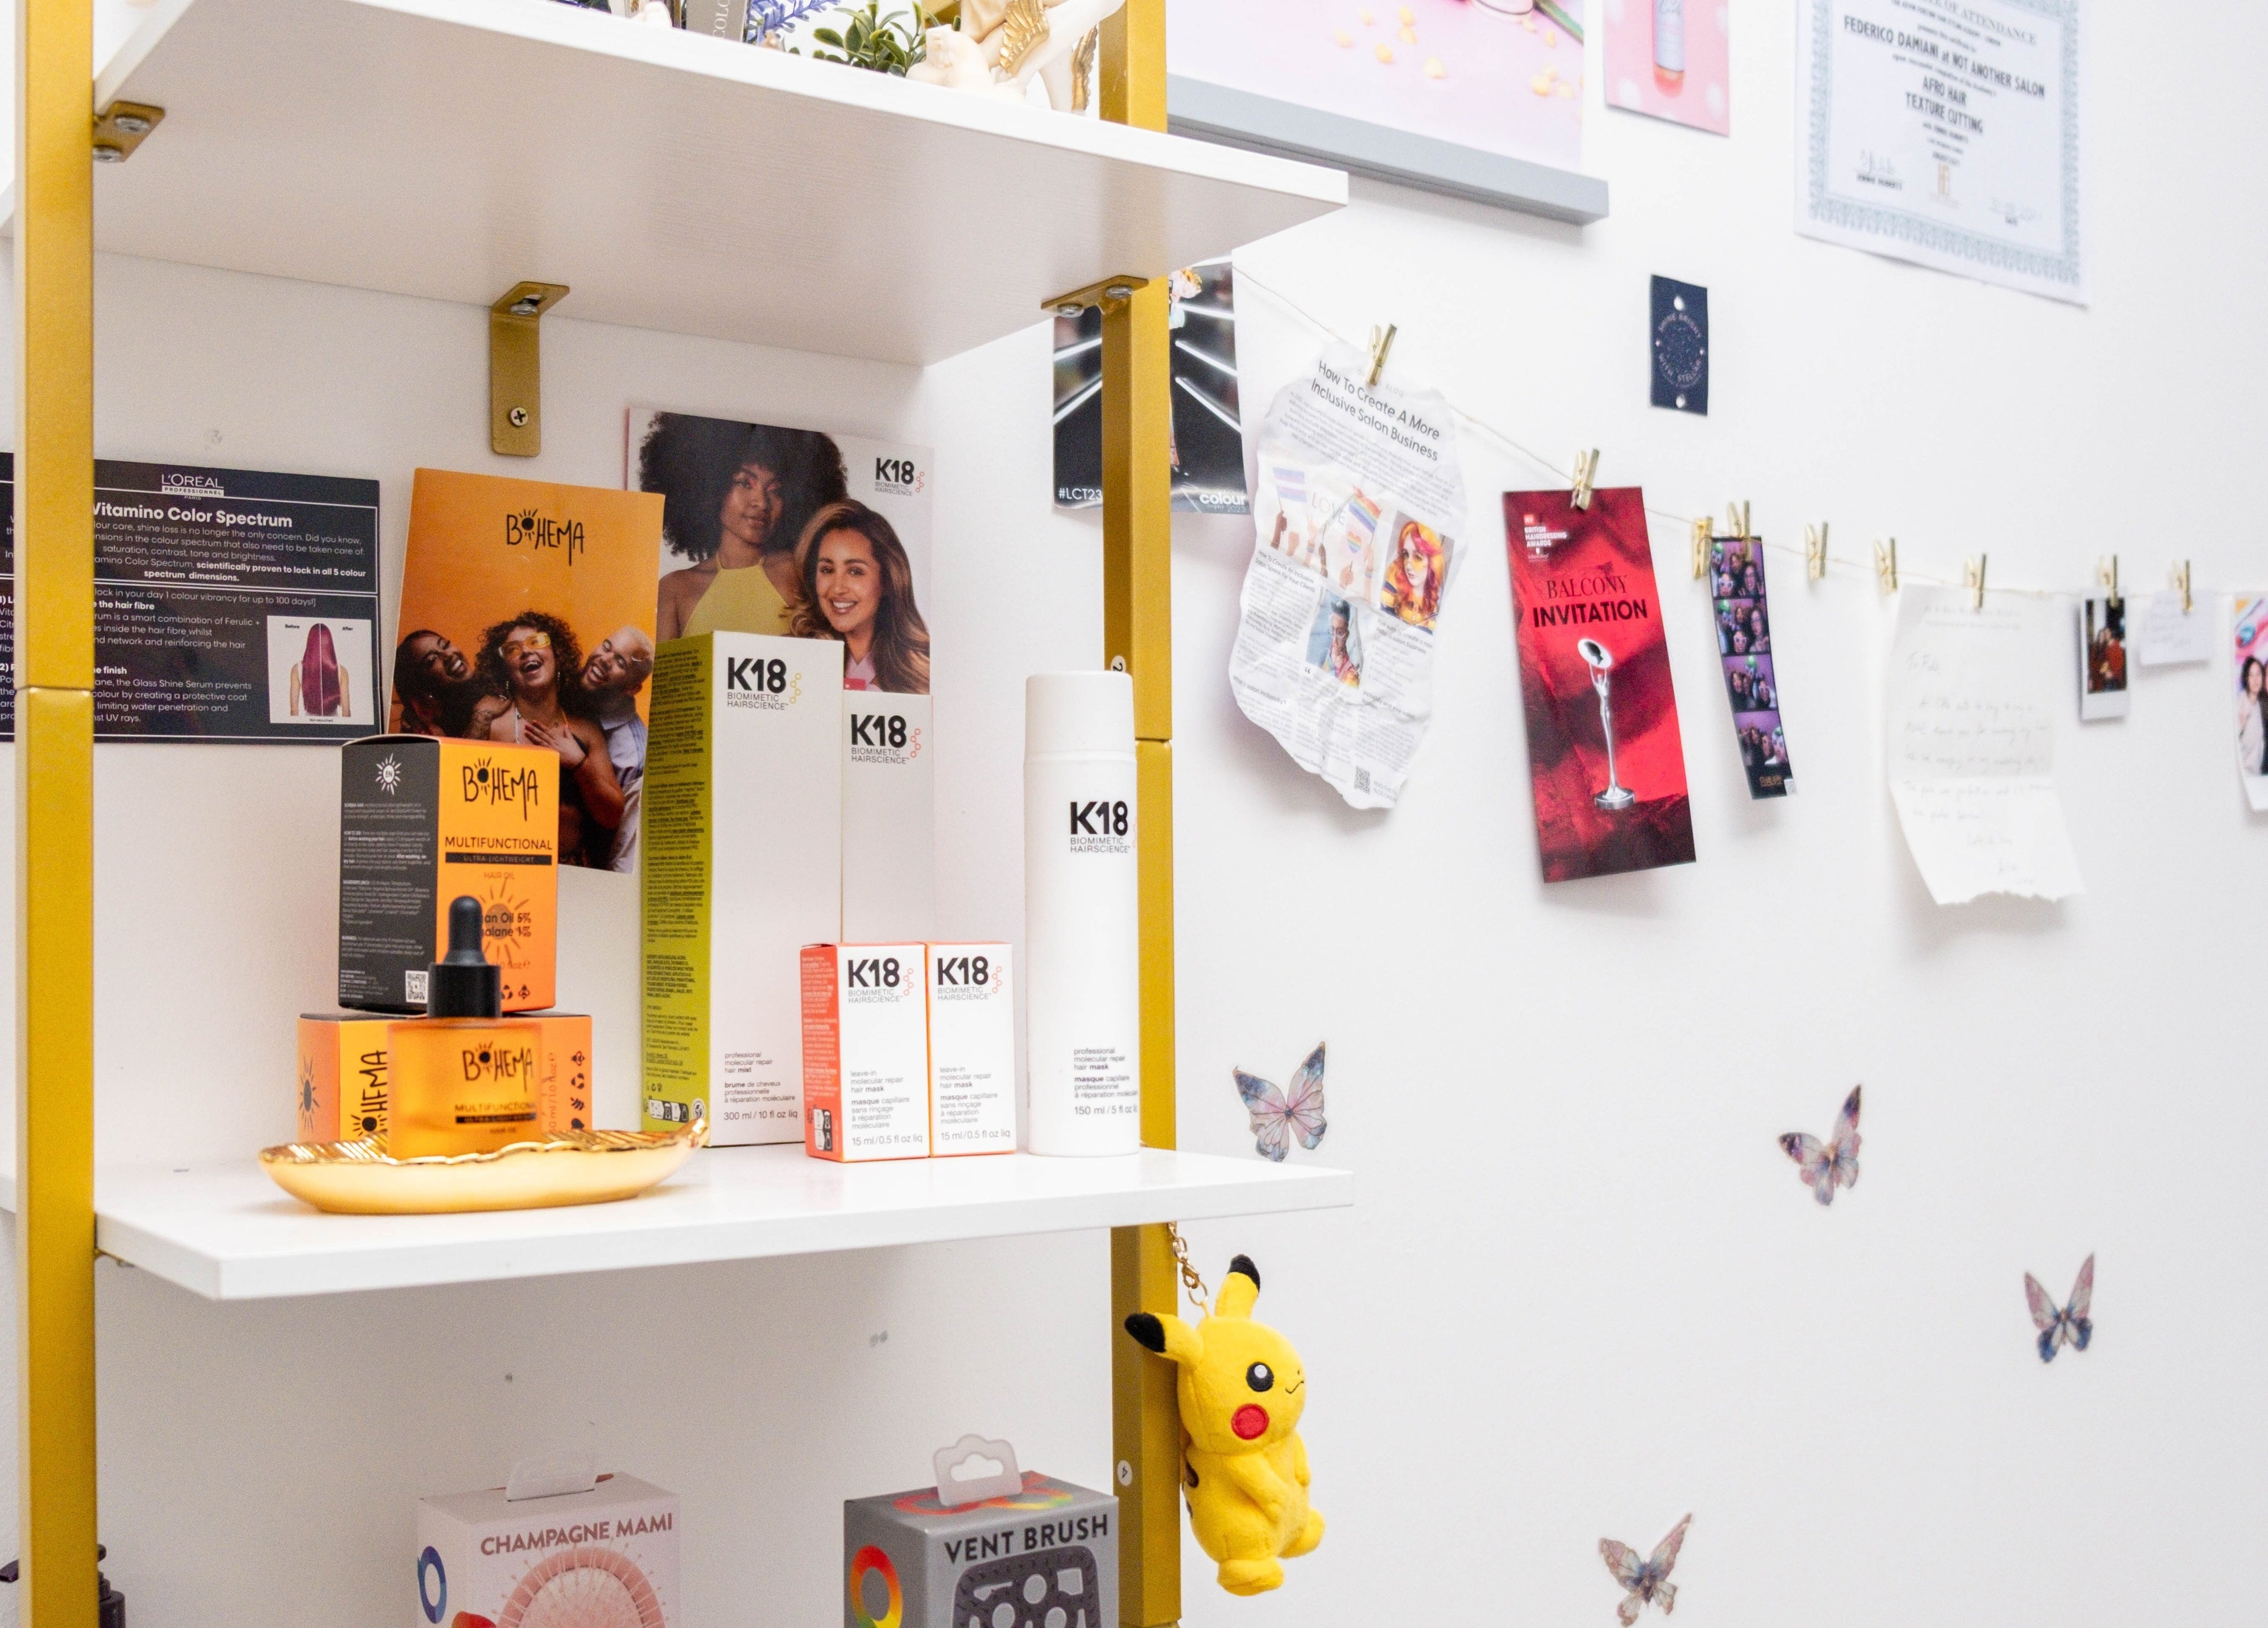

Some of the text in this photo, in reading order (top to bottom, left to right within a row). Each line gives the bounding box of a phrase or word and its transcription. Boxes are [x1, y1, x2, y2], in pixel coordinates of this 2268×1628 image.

[1962, 8, 2036, 45] ATTENDANCE
[1844, 15, 1893, 44] FEDERICO
[1898, 31, 1938, 58] DAMIANI
[1953, 52, 1969, 70] NOT
[1970, 60, 2011, 87] ANOTHER
[2015, 75, 2045, 98] SALON
[1922, 75, 1945, 97] AFRO
[1948, 86, 1966, 106] HAIR
[1906, 91, 1945, 119] TEXTURE
[1948, 108, 1983, 134] CUTTING
[1318, 360, 1440, 440] How To Create A More
[1311, 378, 1356, 416] Inclusive
[1358, 408, 1389, 436] Salon
[1391, 427, 1438, 462] Business
[162, 474, 224, 489] L'ORÉAL
[875, 457, 914, 485] K18
[164, 487, 222, 495] PROFESSIONNEL
[875, 481, 909, 491] BIOMIMETIC
[1058, 487, 1102, 500] #LCT23
[1199, 491, 1245, 505] colour
[93, 502, 292, 528] Vitamino Color Spectrum
[138, 523, 159, 532] shine
[163, 524, 178, 533] loss
[203, 526, 229, 538] longer
[232, 529, 245, 537] the
[248, 530, 265, 541] only
[305, 533, 319, 541] Did
[338, 535, 361, 545] know,
[506, 508, 585, 566] BOHEMA
[1525, 532, 1567, 540] HAIRDRESSING
[103, 544, 276, 562] saturation, contrast, tone and brightness.
[125, 556, 148, 565] Color
[197, 561, 250, 573] scientifically
[294, 565, 311, 574] lock
[322, 567, 332, 575] all
[340, 568, 366, 577] colour
[144, 571, 239, 581] spectrum dimensions.
[1547, 574, 1627, 599] BALCONY
[99, 600, 155, 610] the hair fibre
[147, 590, 163, 601] day
[171, 592, 198, 601] colour
[201, 593, 237, 605] vibrancy
[239, 595, 250, 603] for
[253, 598, 263, 606] up
[276, 597, 289, 605] 100
[1533, 599, 1647, 628] INVITATION
[103, 666, 127, 675] finish
[728, 657, 787, 693] K18
[728, 692, 779, 702] BIOMIMETIC
[850, 714, 907, 748] K18
[852, 748, 900, 756] BIOMIMETIC
[462, 757, 539, 821] BOHEMA
[1070, 800, 1128, 836] K18
[445, 836, 553, 850] MULTIFUNCTIONAL
[1070, 837, 1123, 845] BIOMIMETIC
[501, 913, 532, 923] Oil 5%
[518, 927, 532, 937] 1%
[848, 958, 900, 988] K18
[937, 956, 988, 986] K18
[848, 988, 894, 997] BIOMIMETIC
[462, 1041, 533, 1092] BOHEMA
[724, 1112, 739, 1120] 300
[742, 1111, 751, 1119] ml
[789, 1110, 797, 1119] liq
[852, 1137, 861, 1146] 15
[894, 1135, 898, 1143] fl
[913, 1134, 923, 1143] liq
[480, 1512, 673, 1555] CHAMPAGNE MAMI
[944, 1513, 1107, 1565] VENT BRUSH
